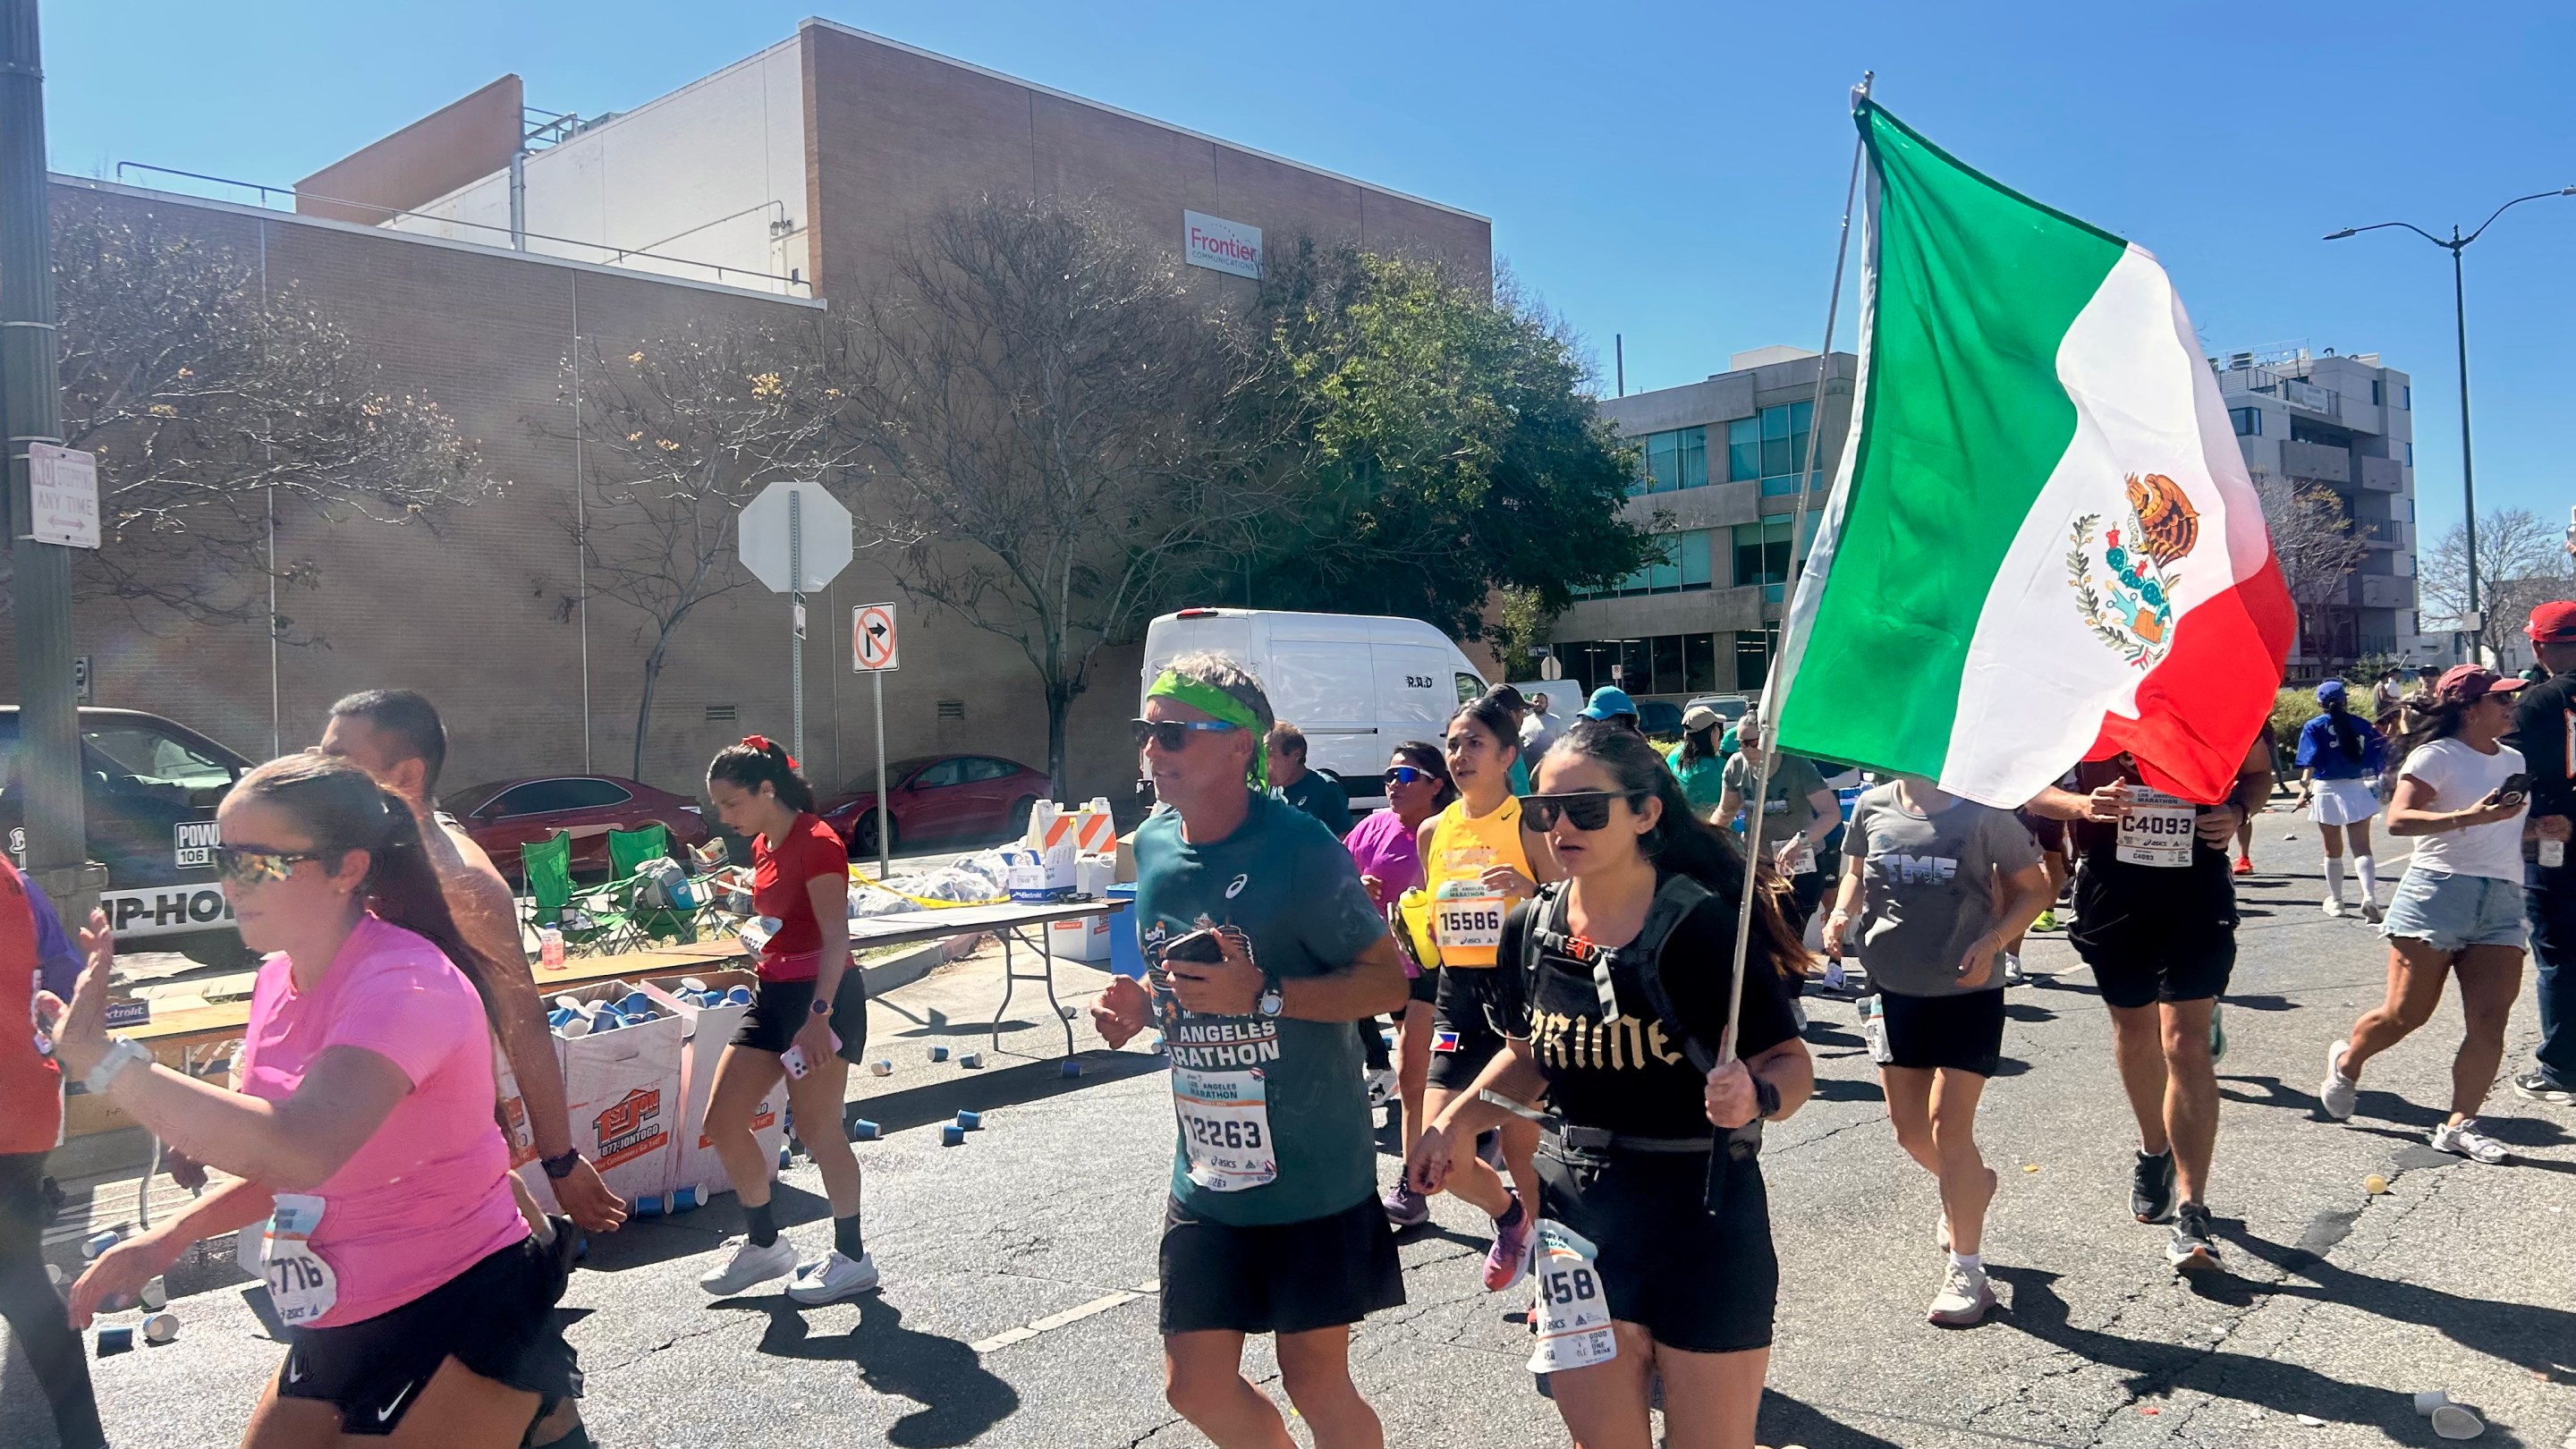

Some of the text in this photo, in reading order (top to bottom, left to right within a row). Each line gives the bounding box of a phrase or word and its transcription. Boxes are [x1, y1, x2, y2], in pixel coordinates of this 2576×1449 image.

[1191, 226, 1258, 262] Frontier
[1191, 250, 1255, 272] COMMUNICATIONS
[37, 491, 94, 516] ANY TIME
[2122, 815, 2191, 835] C4093
[181, 850, 205, 862] 106
[1440, 911, 1499, 931] 15586
[1180, 1020, 1276, 1043] ANGELES
[1165, 1038, 1281, 1068] ARATHON
[1189, 1087, 1238, 1099] MARATHON
[1203, 1082, 1237, 1090] ANGELES
[1183, 1114, 1262, 1149] 12263
[1538, 1268, 1596, 1309] 458
